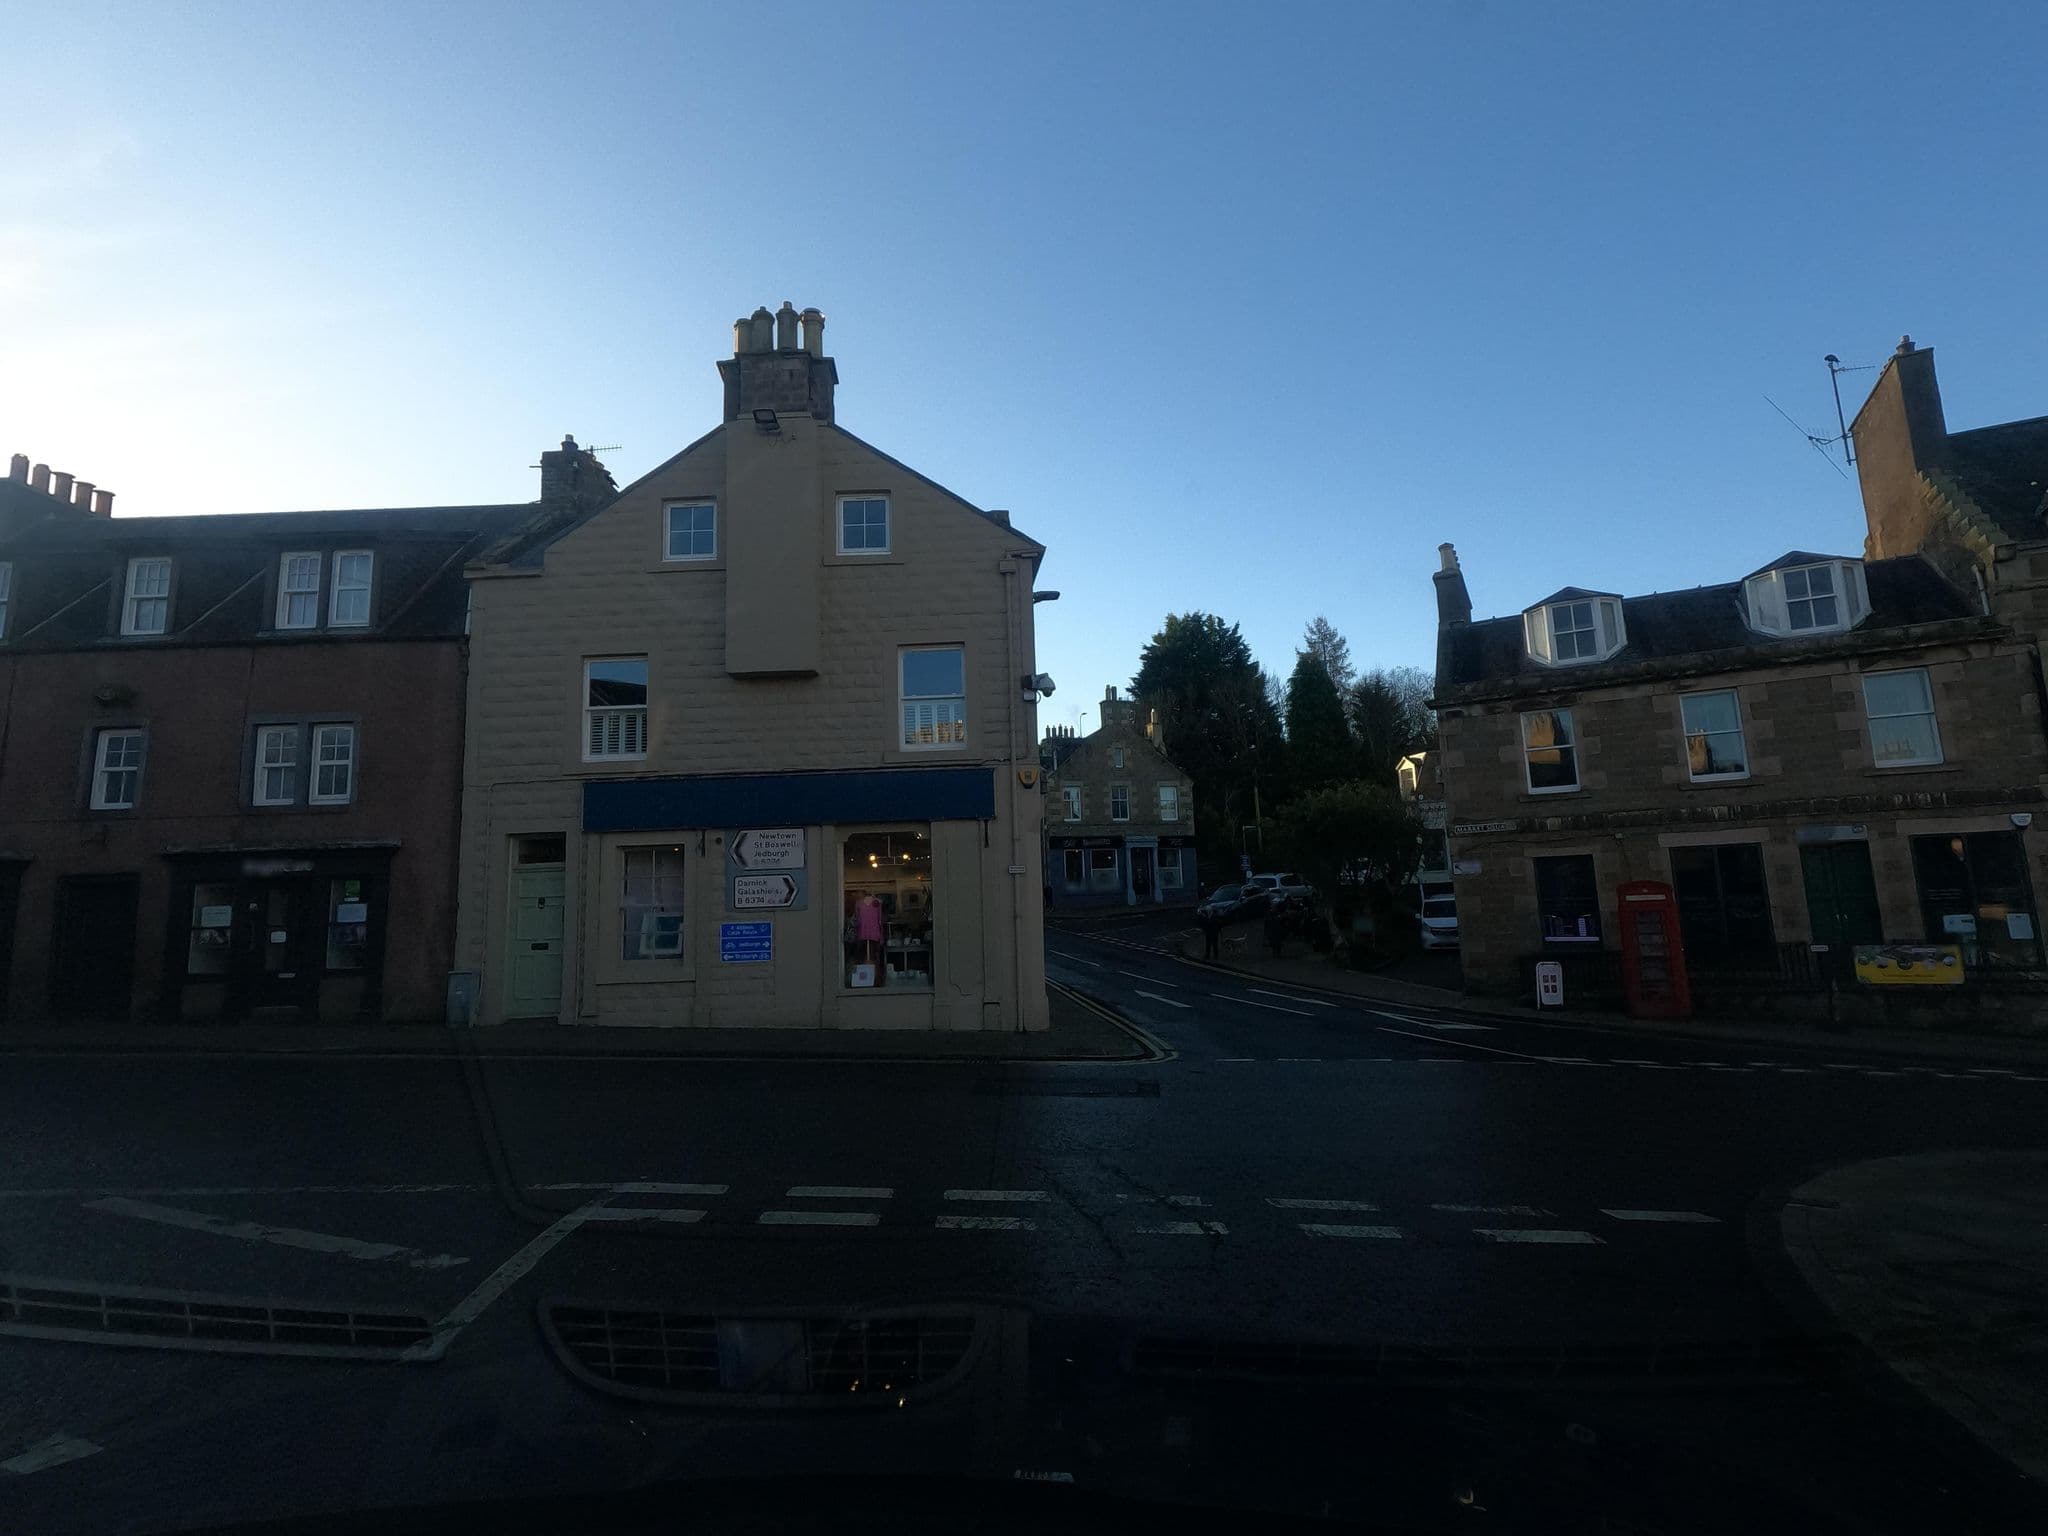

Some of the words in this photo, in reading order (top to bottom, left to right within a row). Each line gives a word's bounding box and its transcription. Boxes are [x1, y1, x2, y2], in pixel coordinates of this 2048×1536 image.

[1456, 824, 1486, 832] MARKET
[759, 832, 797, 840] Newtown
[765, 840, 800, 848] Boswell
[753, 850, 790, 858] Jedburgh
[737, 879, 767, 887] Darnick
[745, 896, 765, 904] 6374
